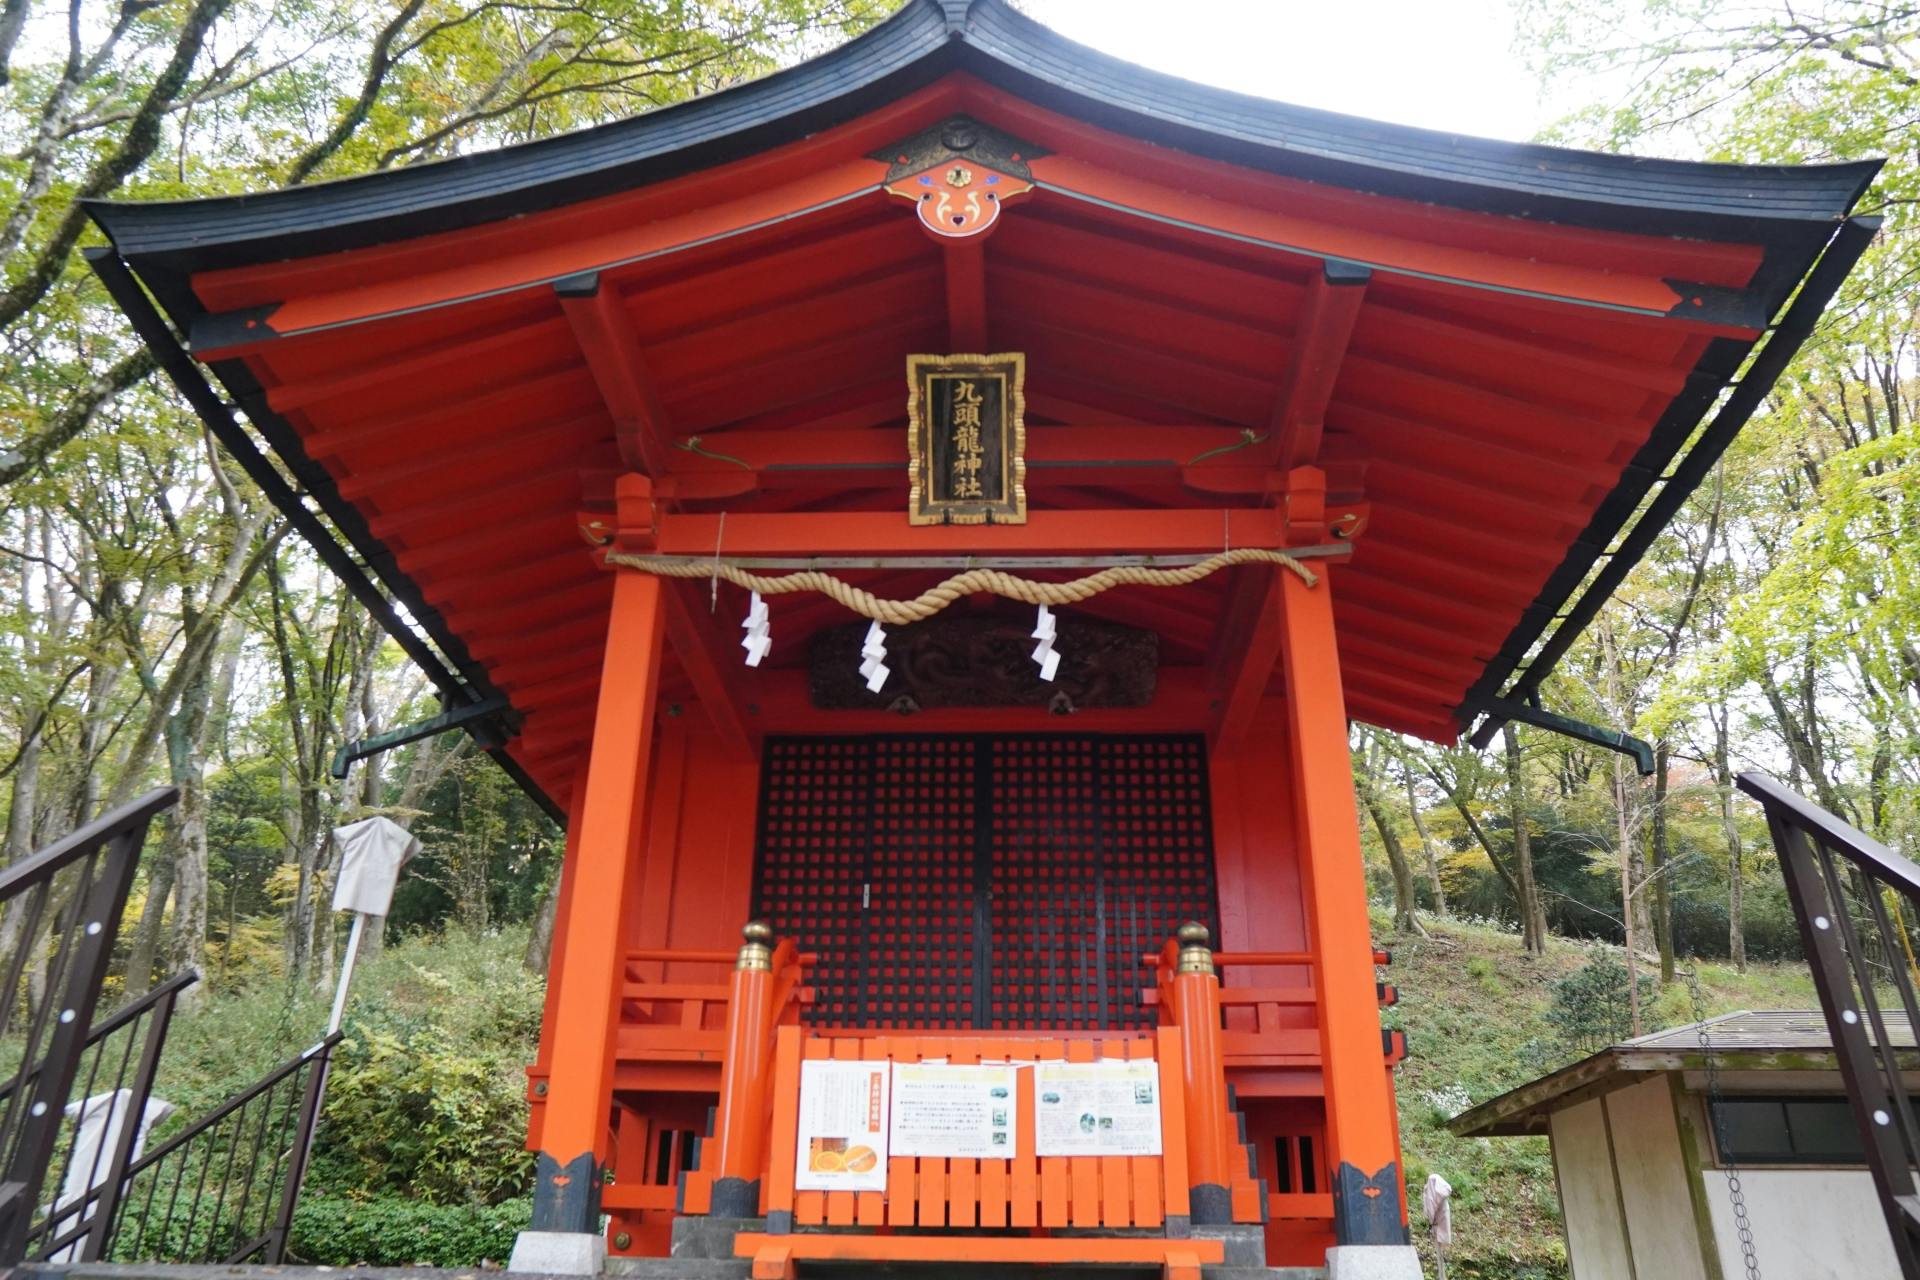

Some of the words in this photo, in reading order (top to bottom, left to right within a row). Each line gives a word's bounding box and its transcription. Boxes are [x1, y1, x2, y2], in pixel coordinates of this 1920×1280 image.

[952, 380, 984, 498] 九頭龍神社
